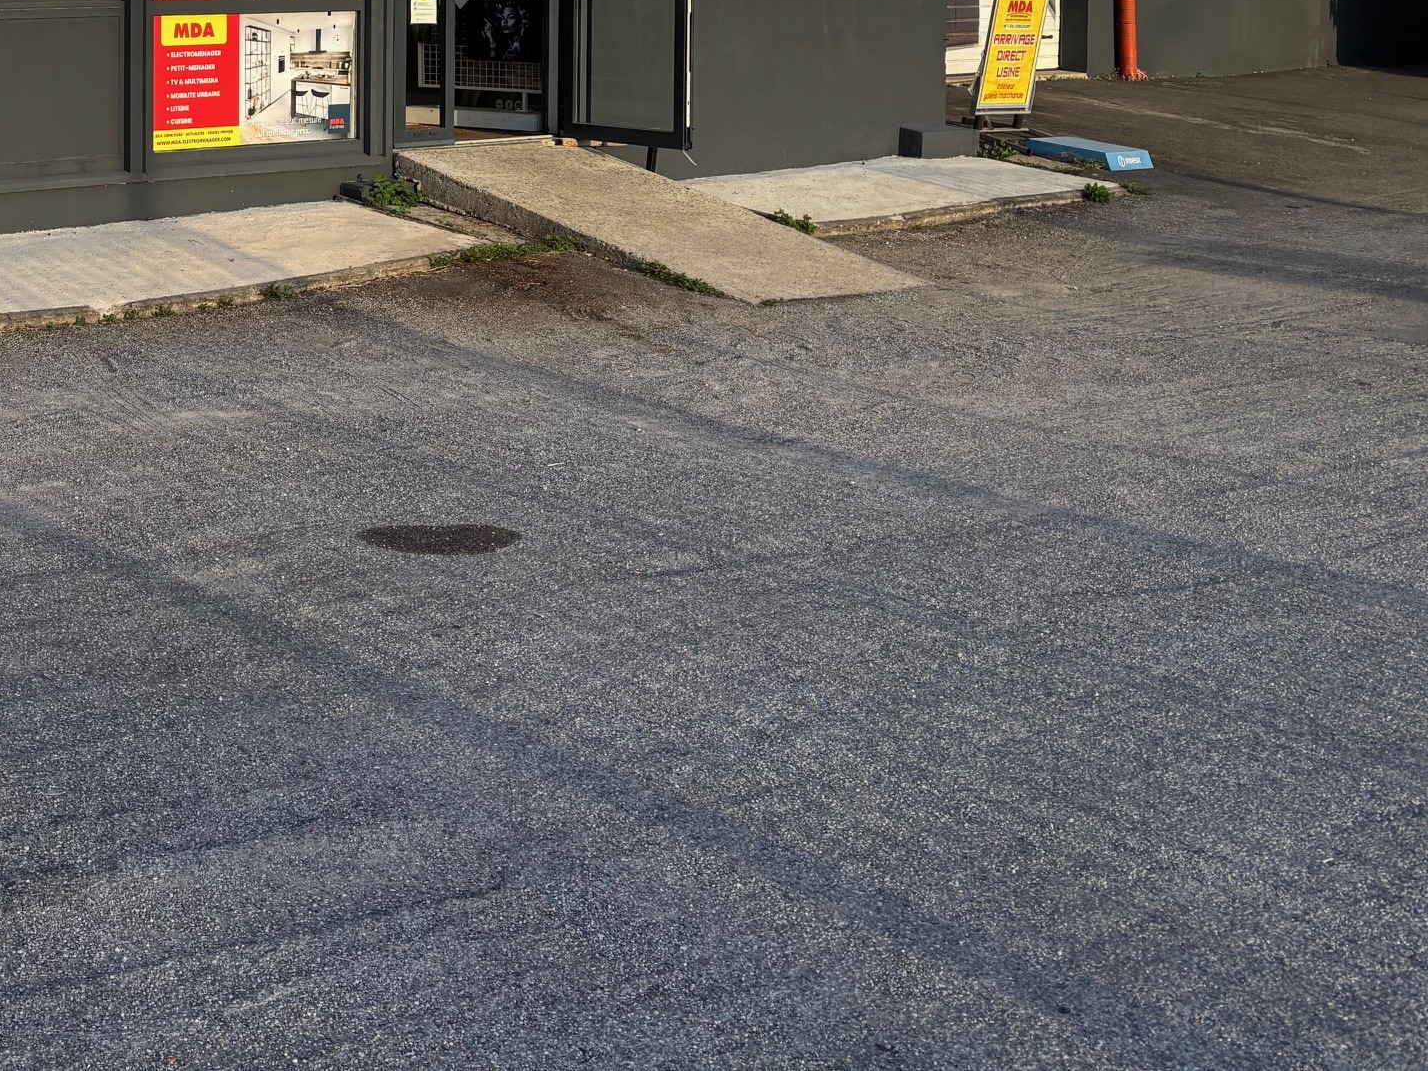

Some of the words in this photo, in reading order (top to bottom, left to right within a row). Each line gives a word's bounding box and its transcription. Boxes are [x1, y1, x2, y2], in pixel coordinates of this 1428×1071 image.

[1007, 0, 1033, 13] MDA
[174, 22, 215, 39] MDA
[993, 34, 1035, 45] ARRIVAGE
[171, 50, 222, 58] ELECTROMENAGER
[996, 50, 1026, 61] DIRECT
[996, 67, 1020, 78] USINE
[185, 77, 219, 85] MULTIMEDIA
